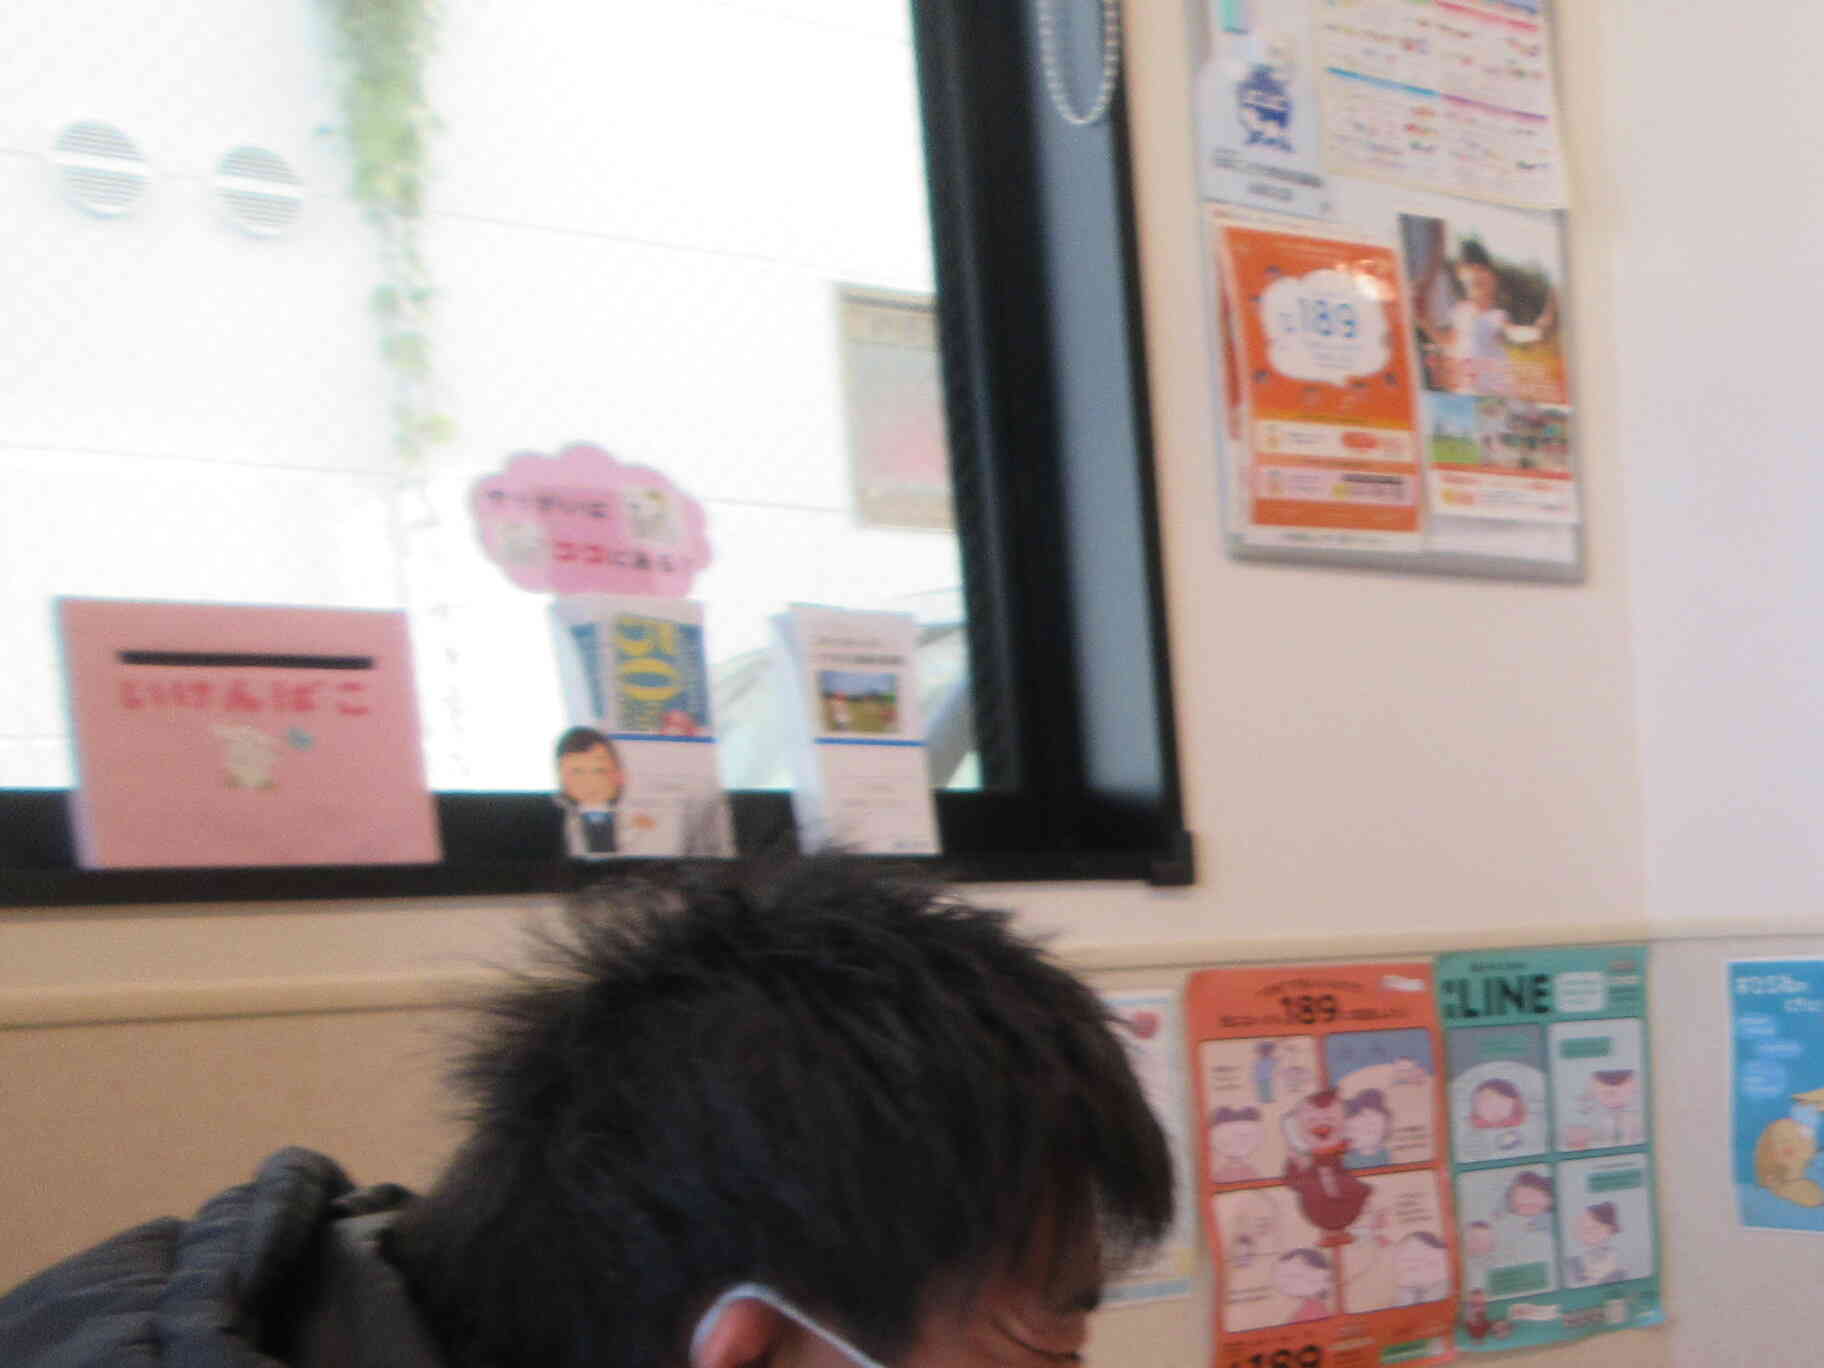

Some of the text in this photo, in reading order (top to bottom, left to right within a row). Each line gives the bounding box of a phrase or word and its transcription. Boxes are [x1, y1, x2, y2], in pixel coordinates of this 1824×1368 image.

[119, 679, 369, 716] いけんばこ
[1280, 994, 1338, 1025] 189
[1459, 973, 1550, 1018] LINE
